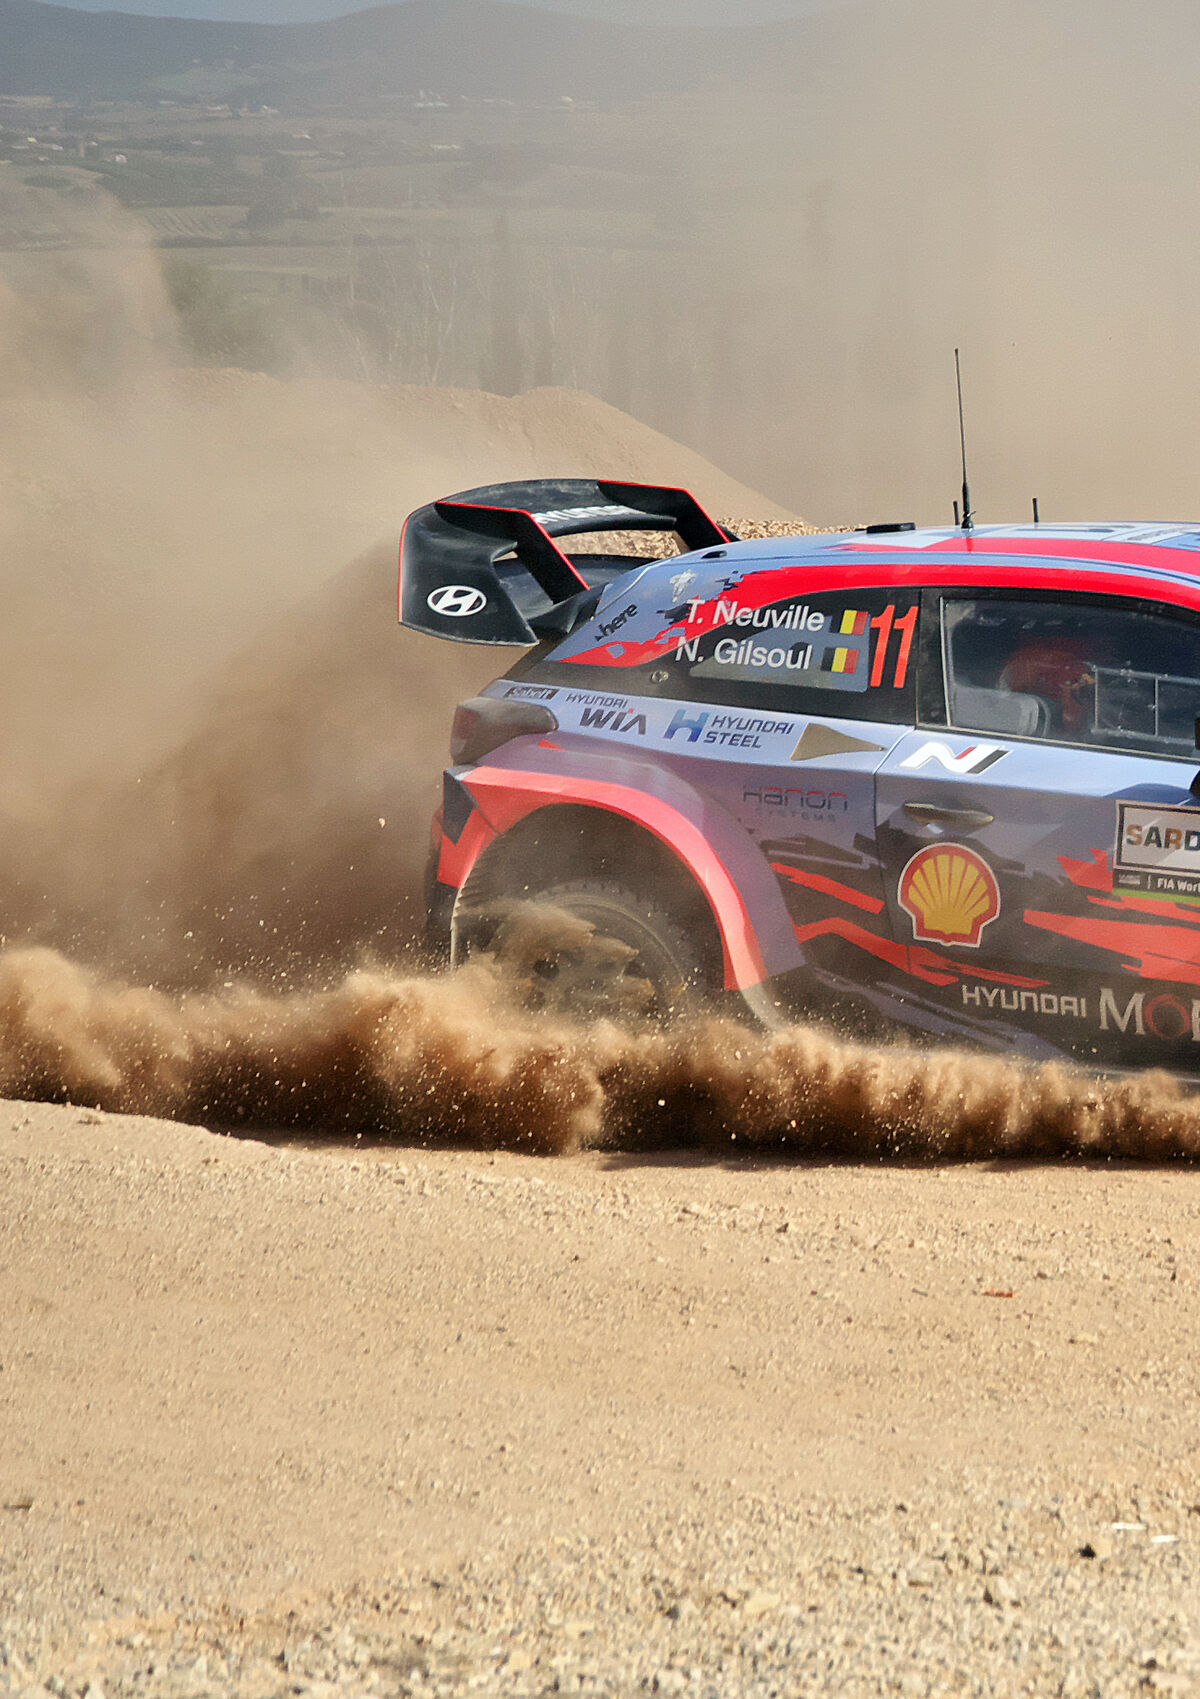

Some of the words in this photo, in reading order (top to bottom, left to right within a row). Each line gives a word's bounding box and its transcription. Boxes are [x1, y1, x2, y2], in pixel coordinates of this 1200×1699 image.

[600, 603, 638, 637] here
[686, 600, 706, 624] T.
[712, 599, 825, 632] Neuville
[675, 636, 704, 662] N.
[714, 638, 813, 670] Gilsoul
[870, 604, 919, 688] 11
[565, 693, 628, 709] HYUNDAI
[579, 707, 647, 735] WIA
[710, 715, 796, 735] HYUNDAI
[703, 730, 763, 749] STEEL
[1157, 878, 1175, 890] FIA
[960, 984, 1088, 1018] HYUNDAI
